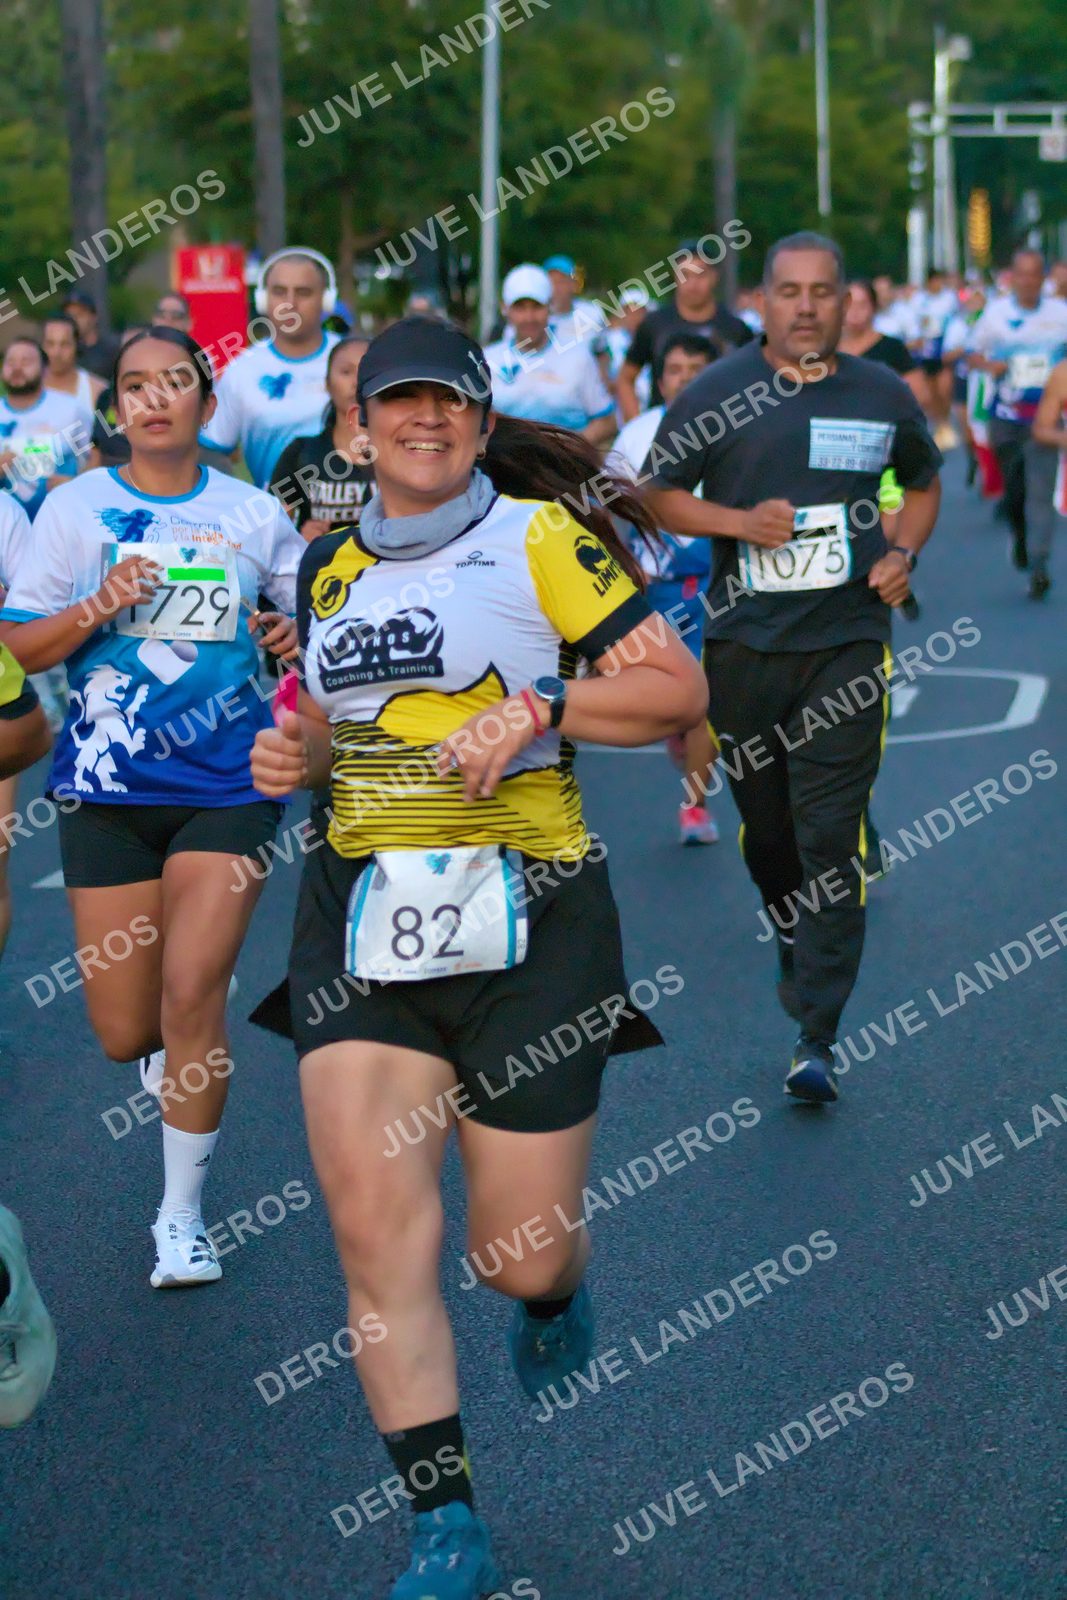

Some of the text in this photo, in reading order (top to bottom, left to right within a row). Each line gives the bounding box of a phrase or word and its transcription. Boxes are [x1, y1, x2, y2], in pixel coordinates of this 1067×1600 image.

[755, 540, 845, 580] 1075
[326, 664, 435, 687] Coaching & Training
[391, 903, 464, 961] 82
